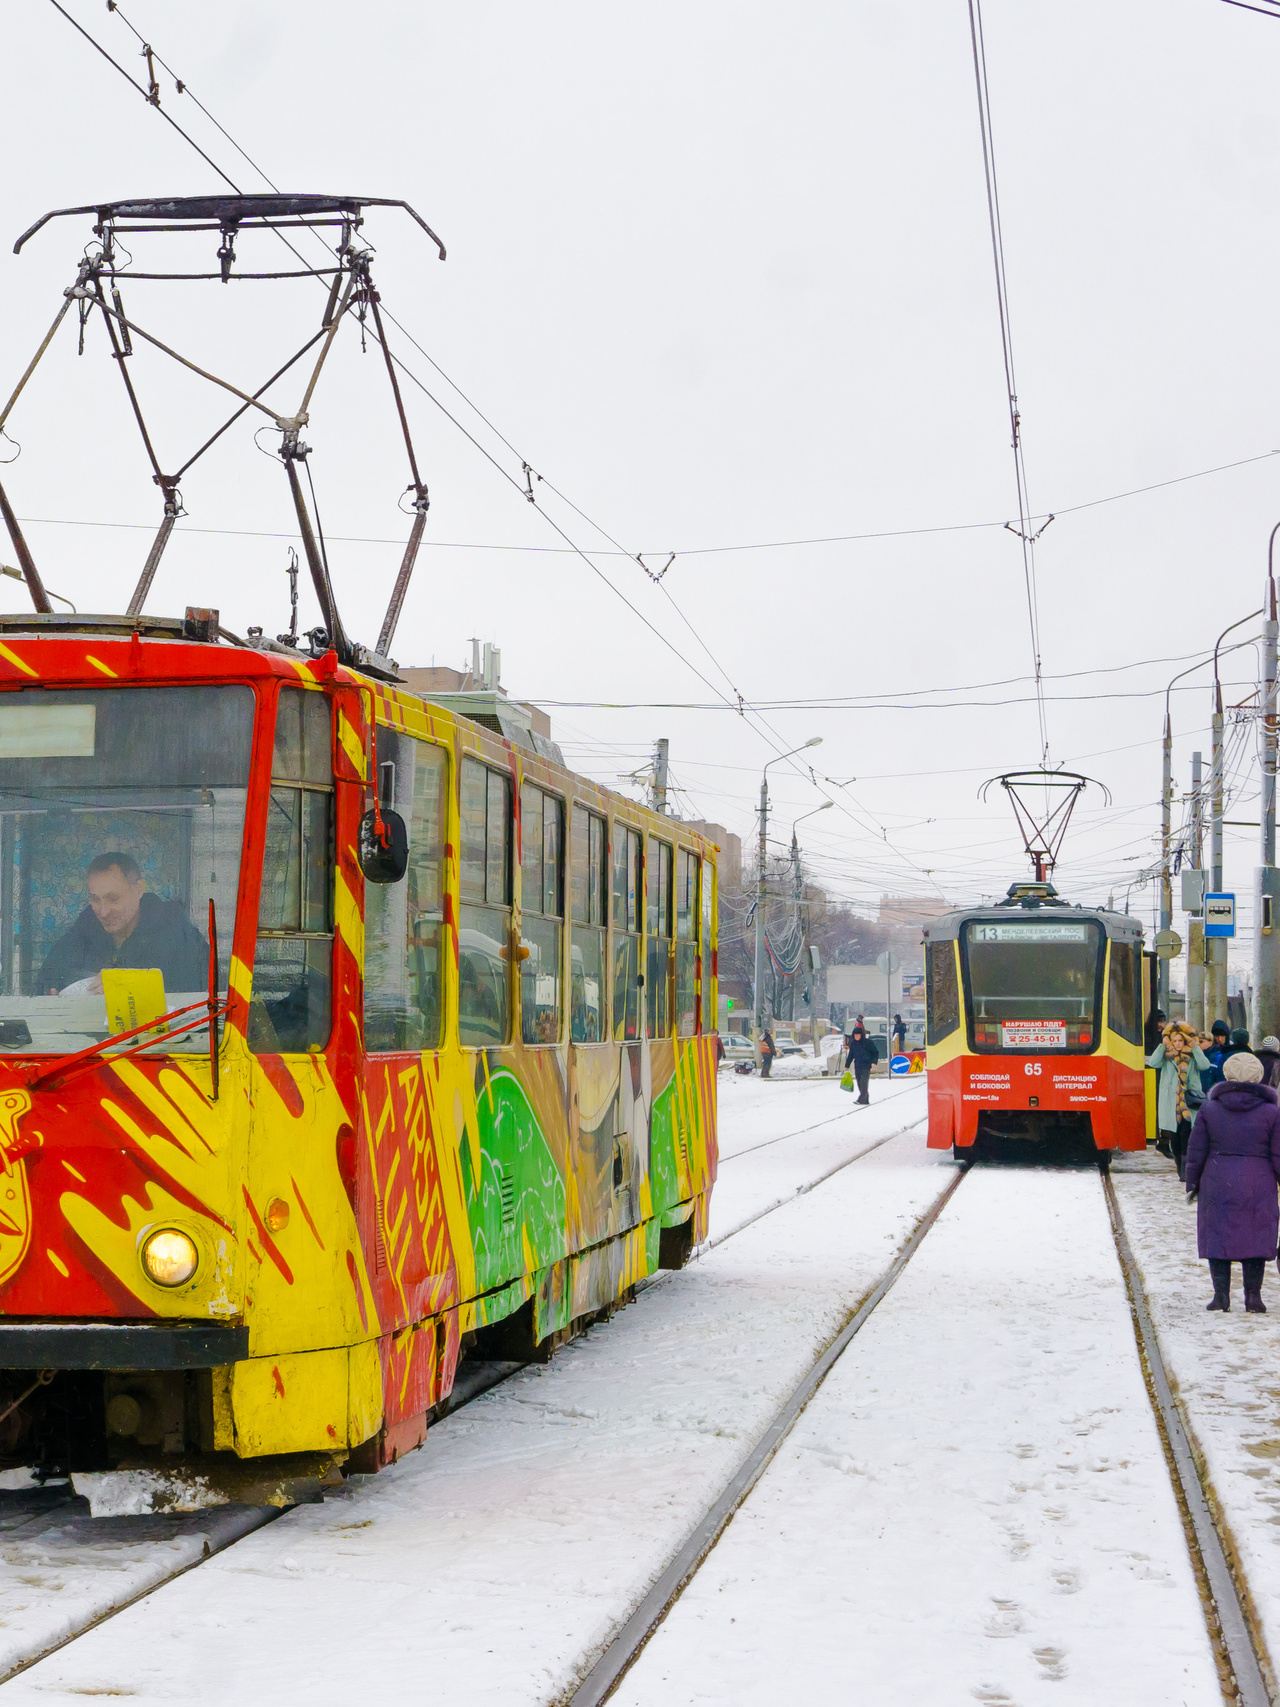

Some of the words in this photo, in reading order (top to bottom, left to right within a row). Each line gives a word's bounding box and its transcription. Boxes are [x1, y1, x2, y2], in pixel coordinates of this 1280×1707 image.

[979, 927, 998, 941] 13
[1018, 1035, 1060, 1043] 25-45-01
[1024, 1063, 1042, 1076] 65
[969, 1073, 1010, 1081] СОБЛЮДАЙ
[1052, 1074, 1098, 1082] ДИСТАНЦИЮ
[976, 1081, 1011, 1090] БОКОВОЙ
